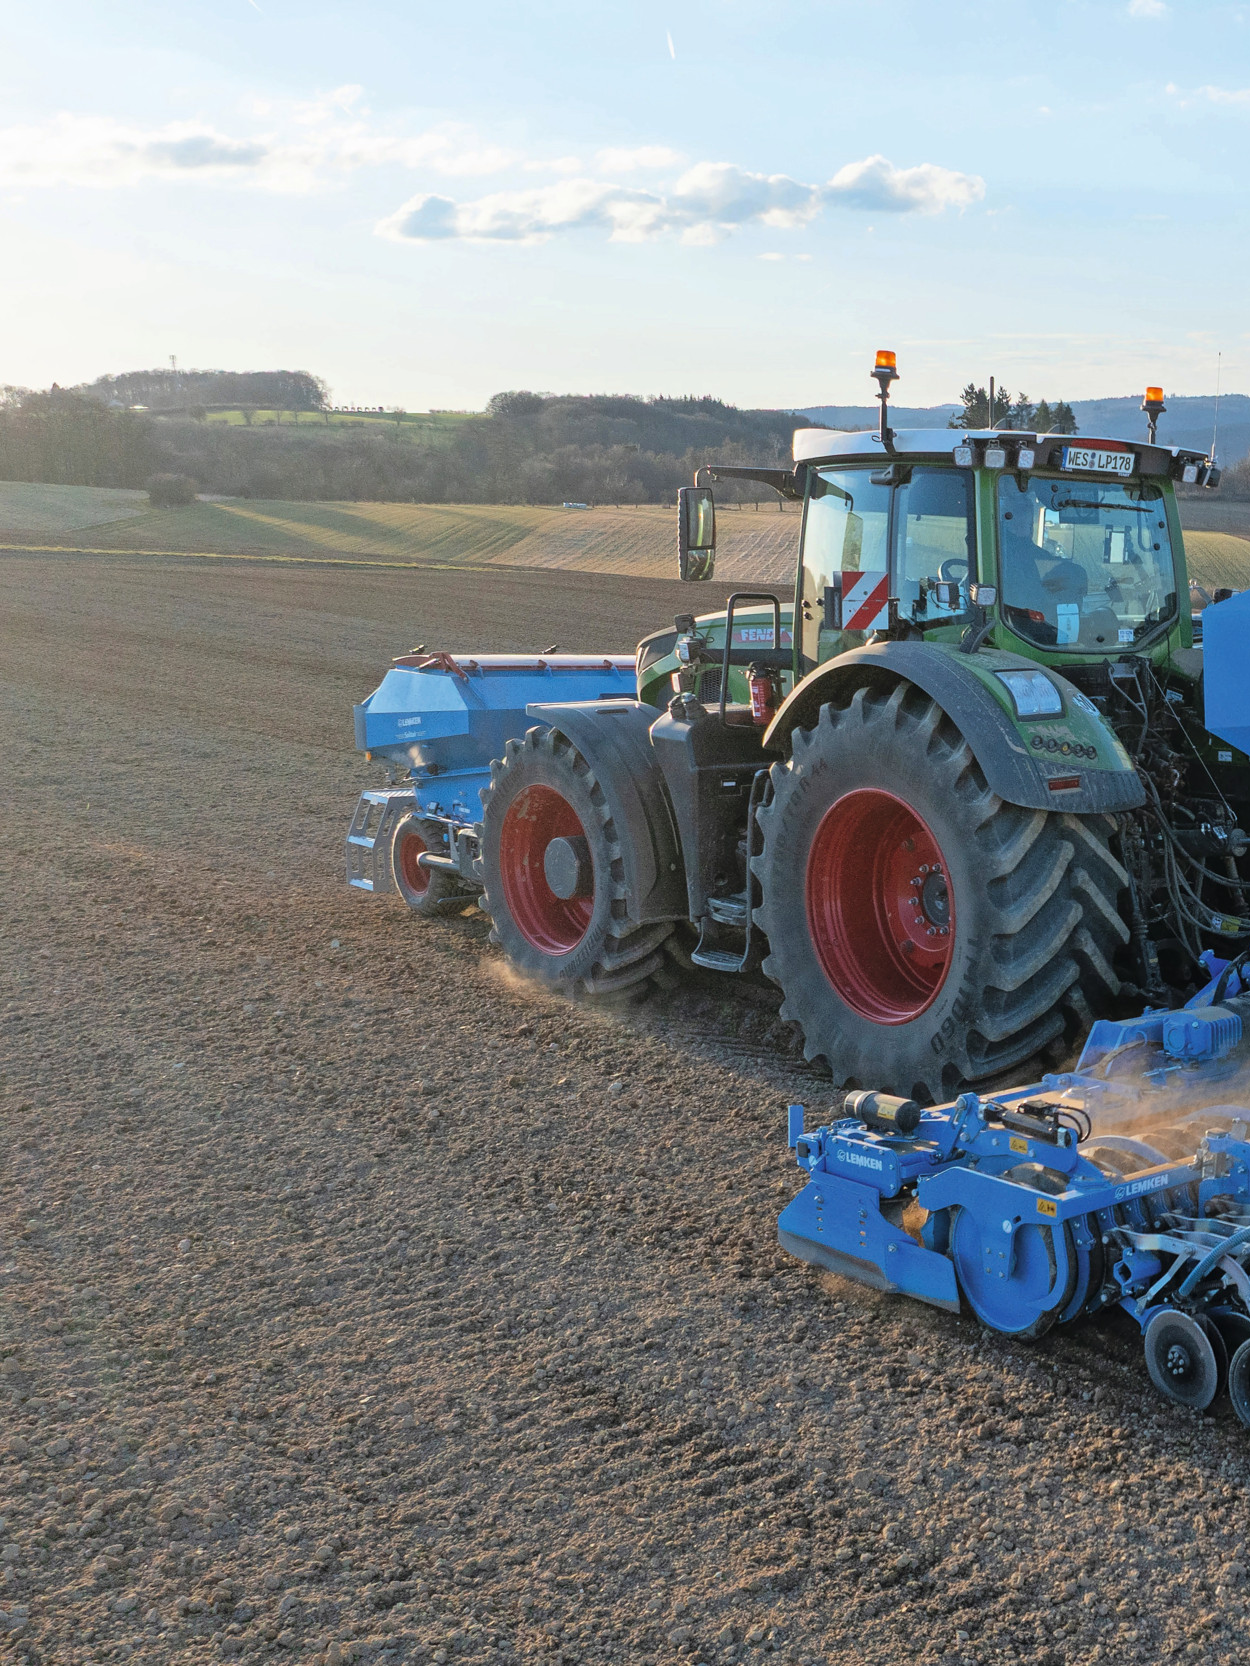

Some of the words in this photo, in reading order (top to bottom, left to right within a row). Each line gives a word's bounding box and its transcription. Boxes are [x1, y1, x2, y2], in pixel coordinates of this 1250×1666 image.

[1068, 450, 1089, 467] WES
[846, 1151, 883, 1172] LEMKEN
[1125, 1173, 1169, 1197] LEMKEN
